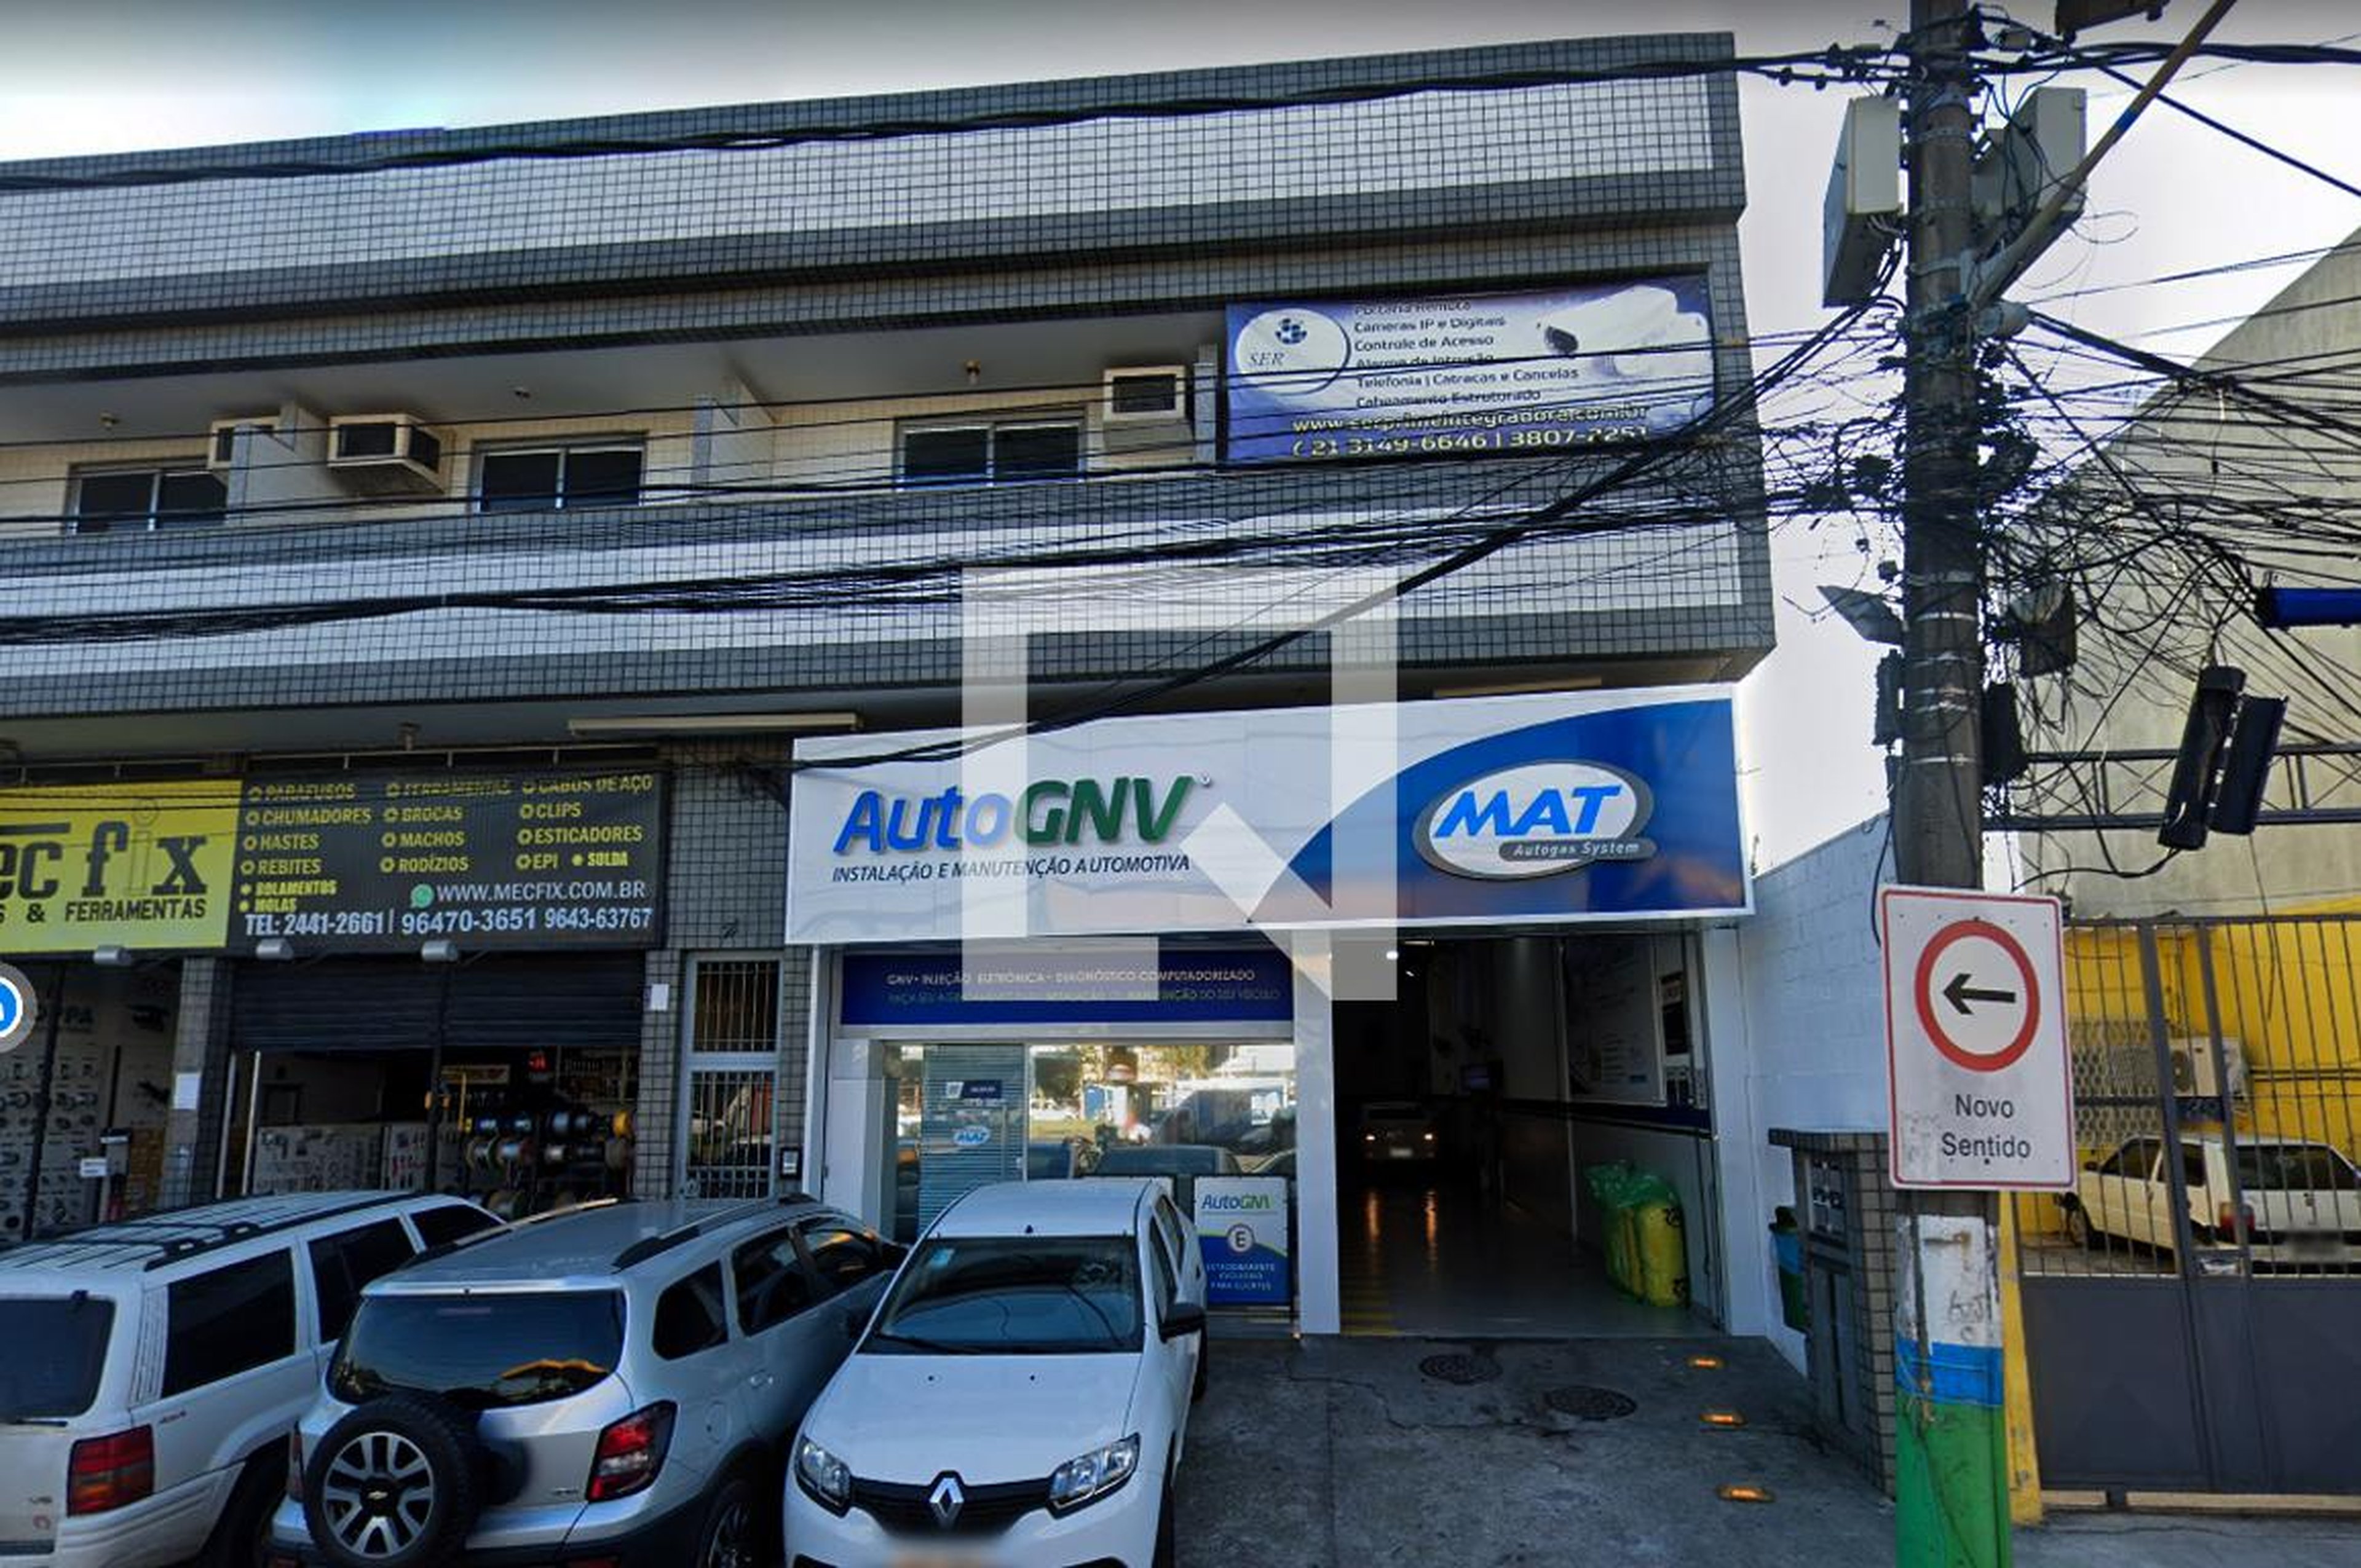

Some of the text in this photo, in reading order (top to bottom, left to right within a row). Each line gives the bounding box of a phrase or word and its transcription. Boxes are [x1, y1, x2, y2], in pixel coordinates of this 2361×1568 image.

[1421, 318, 1434, 330] IP
[1450, 317, 1506, 330] Digitais
[1355, 335, 1494, 352] Controle de Acesso
[1356, 375, 1422, 388] Telefonia
[1433, 372, 1497, 385] Catracas
[1513, 368, 1579, 382] Cancelas
[1348, 433, 1487, 455] 3149-6646
[596, 777, 616, 792] DE
[619, 774, 653, 794] AÇO
[401, 806, 463, 822] BROCAS
[536, 802, 582, 819] CLIPS
[832, 774, 1196, 853] AutoGNV
[1434, 784, 1623, 837] MAT
[260, 833, 320, 851] HASTES
[400, 831, 465, 848] MACHOS
[534, 825, 644, 845] ESTICADORES
[587, 851, 628, 867] SOLDA
[1582, 840, 1640, 858] System
[258, 858, 322, 875] REBITES
[533, 853, 559, 870] EPI
[832, 853, 1191, 884] INSTALAÇÃO E MANUTENÇÃO AUTOMOTIVA
[436, 880, 646, 902] WWW.MECFIX.COM.BR
[26, 902, 45, 923] &
[65, 898, 207, 922] FERRAMENTAS
[283, 911, 384, 935] 2441-2661
[401, 907, 537, 934] 96470-3651
[544, 906, 654, 930] 9643-63767
[1955, 1093, 2015, 1119] Novo
[1941, 1132, 2032, 1160] Sentido
[1235, 1231, 1247, 1248] E
